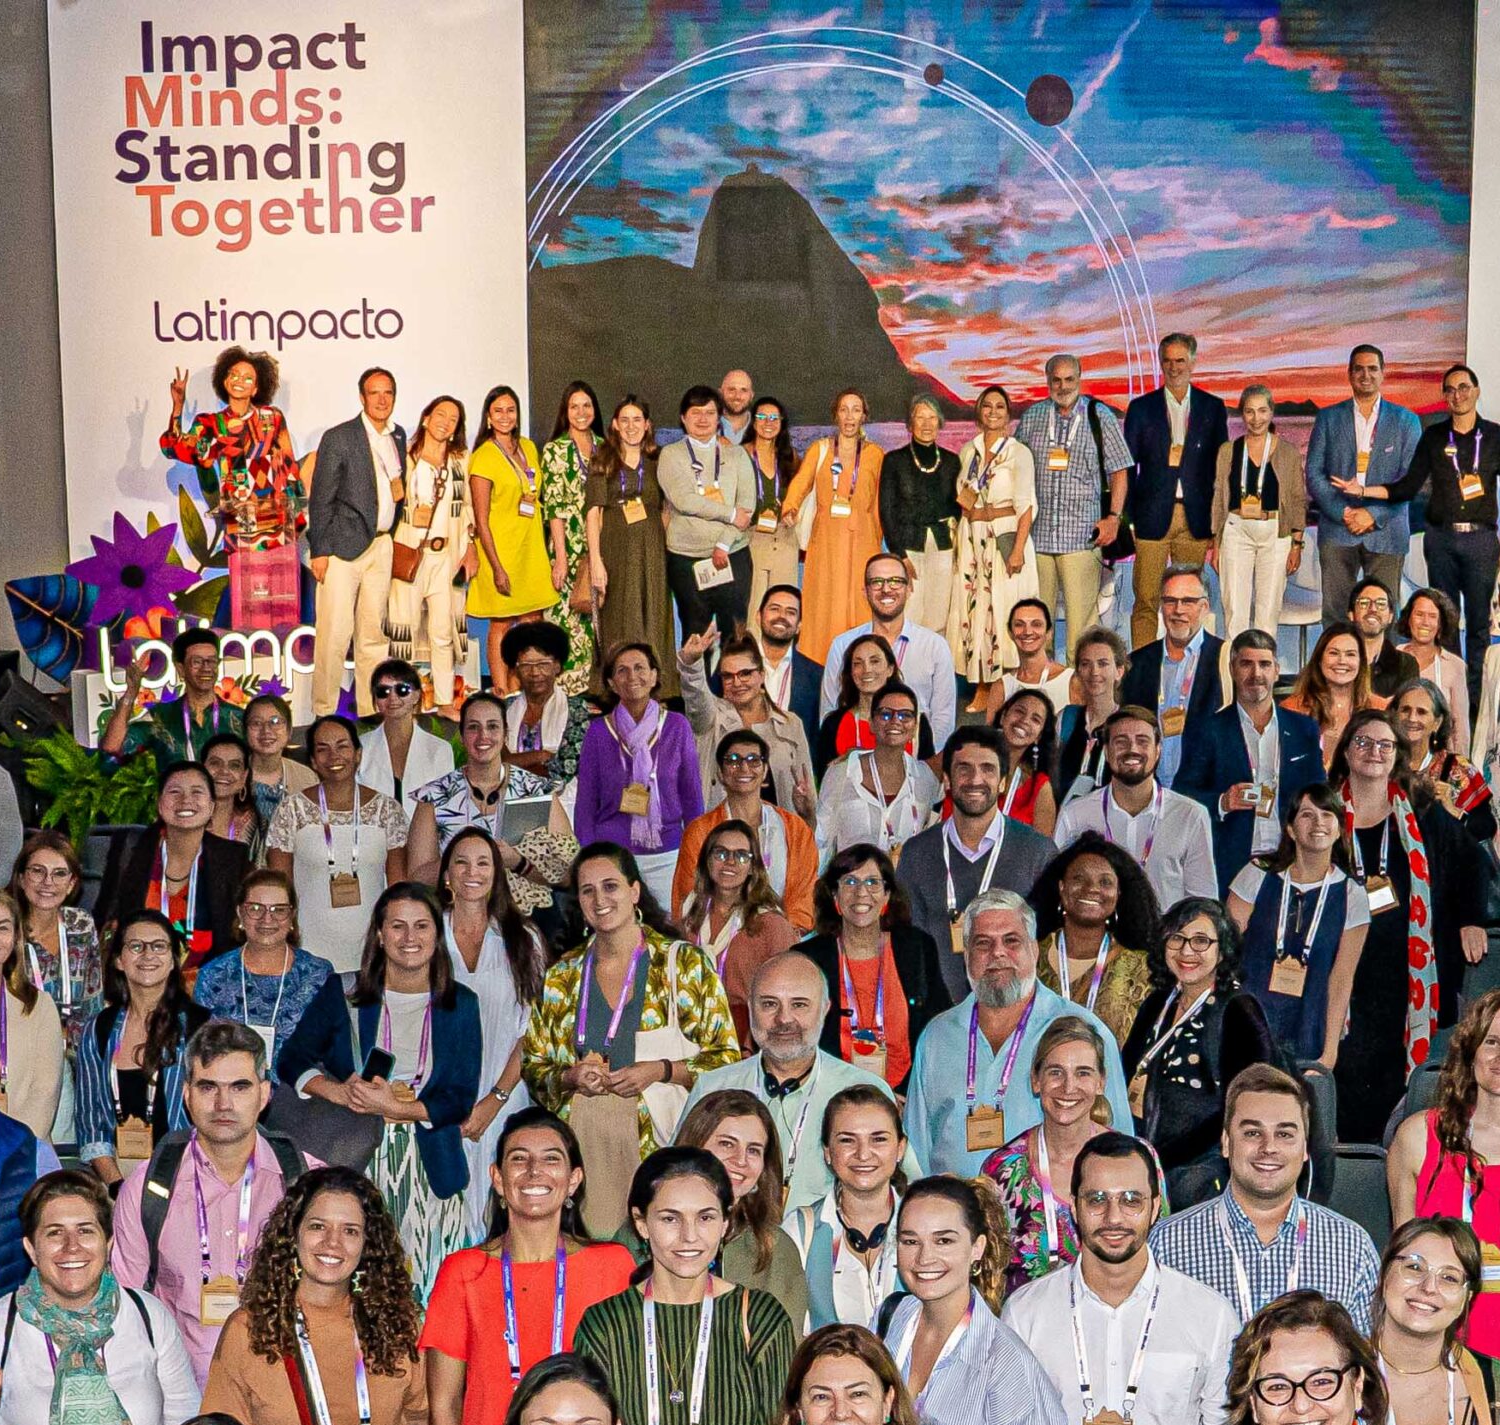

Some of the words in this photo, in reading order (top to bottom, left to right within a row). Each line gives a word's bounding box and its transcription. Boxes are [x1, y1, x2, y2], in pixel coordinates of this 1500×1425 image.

[141, 20, 366, 88] Impact
[125, 68, 342, 128] Minds:
[115, 126, 405, 195] Standing
[136, 180, 435, 252] Together
[154, 299, 404, 351] Latimpacto
